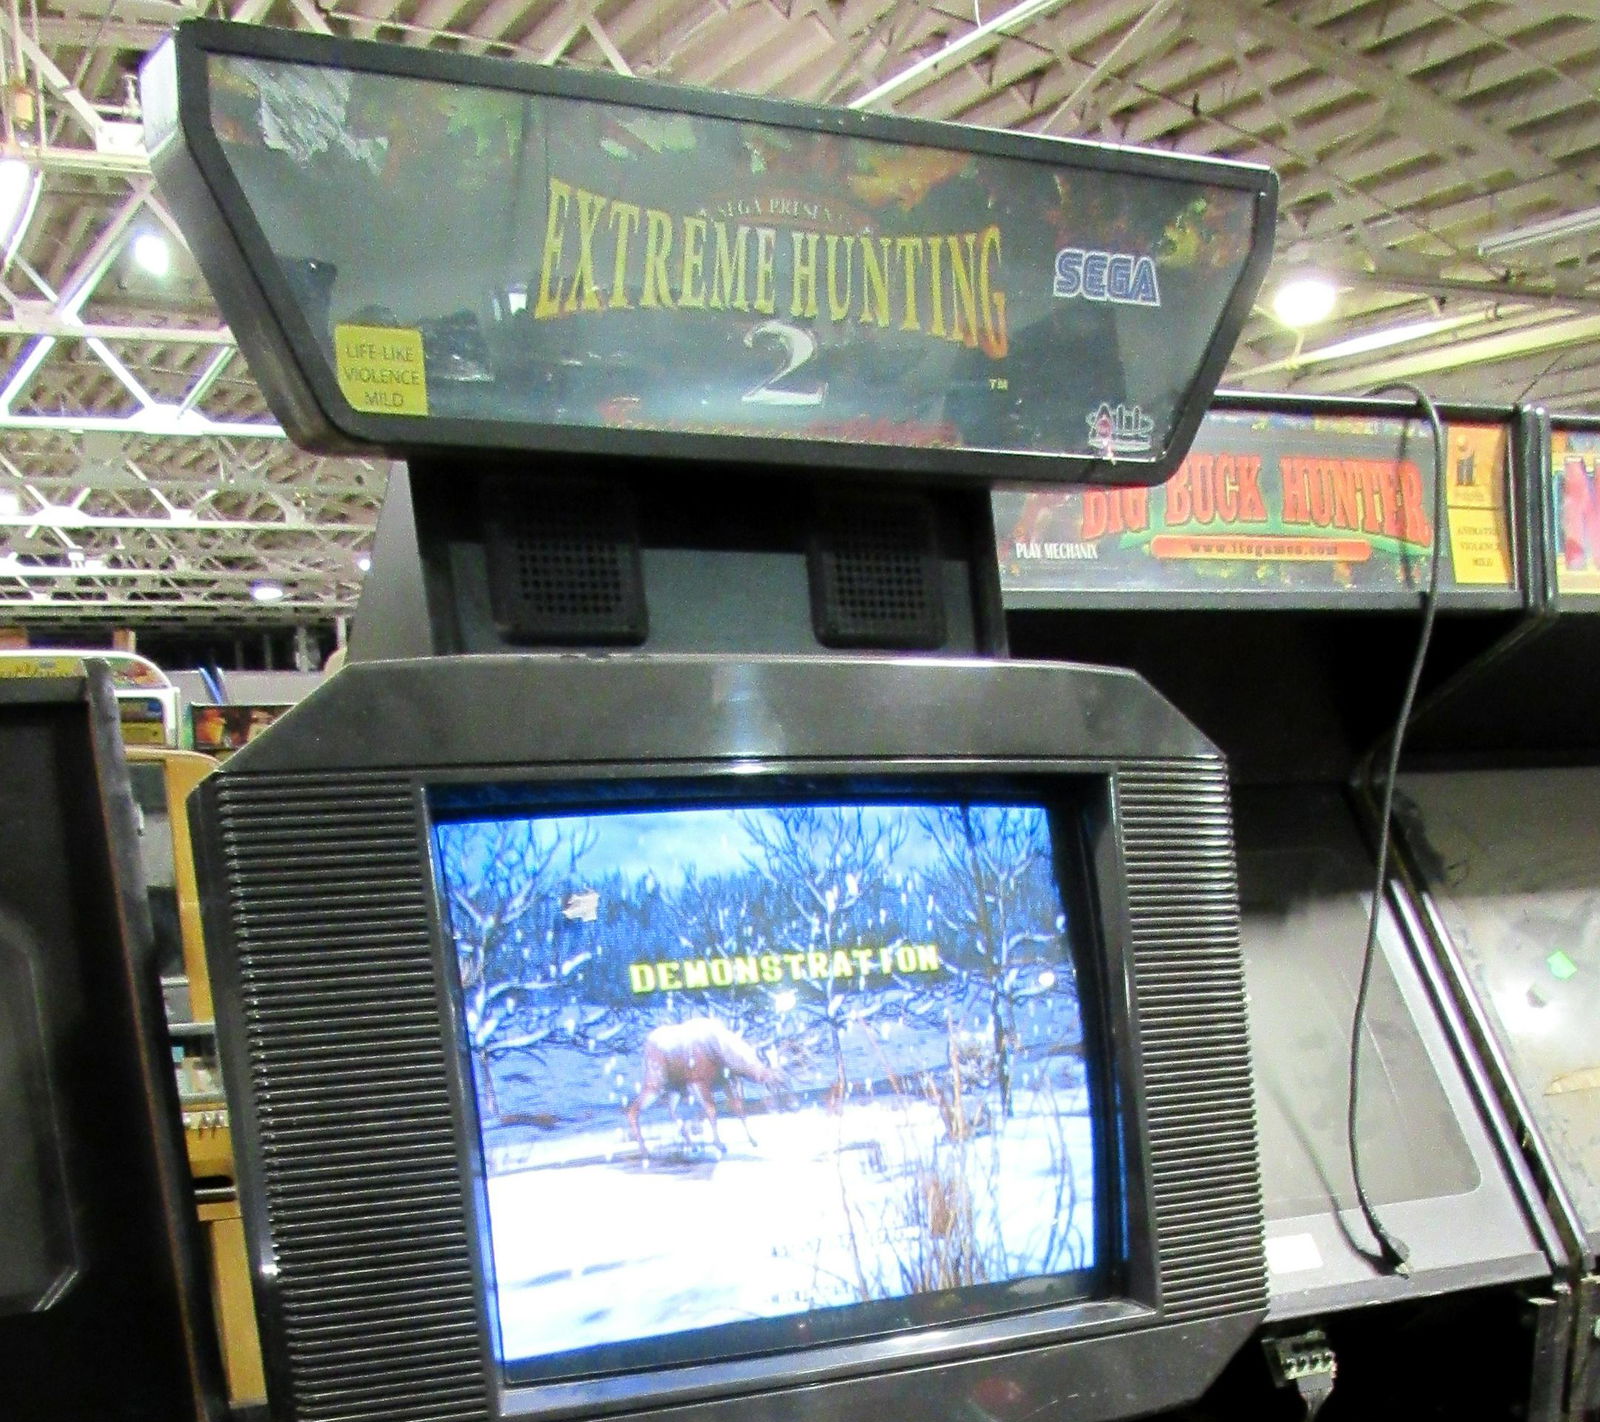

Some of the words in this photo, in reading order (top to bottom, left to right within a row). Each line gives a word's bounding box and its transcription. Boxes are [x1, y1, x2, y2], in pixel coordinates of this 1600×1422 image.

[535, 177, 775, 319] EXTREME
[791, 226, 1008, 360] HUNTING
[1053, 248, 1161, 307] SEGA
[343, 366, 420, 385] VIOLENCE
[741, 320, 829, 405] 2
[364, 392, 404, 408] MILD
[1165, 451, 1267, 526] BUCK
[1281, 455, 1433, 548] HUNTER
[1015, 542, 1041, 558] PLAY
[630, 944, 940, 993] DEMONSTRATION
